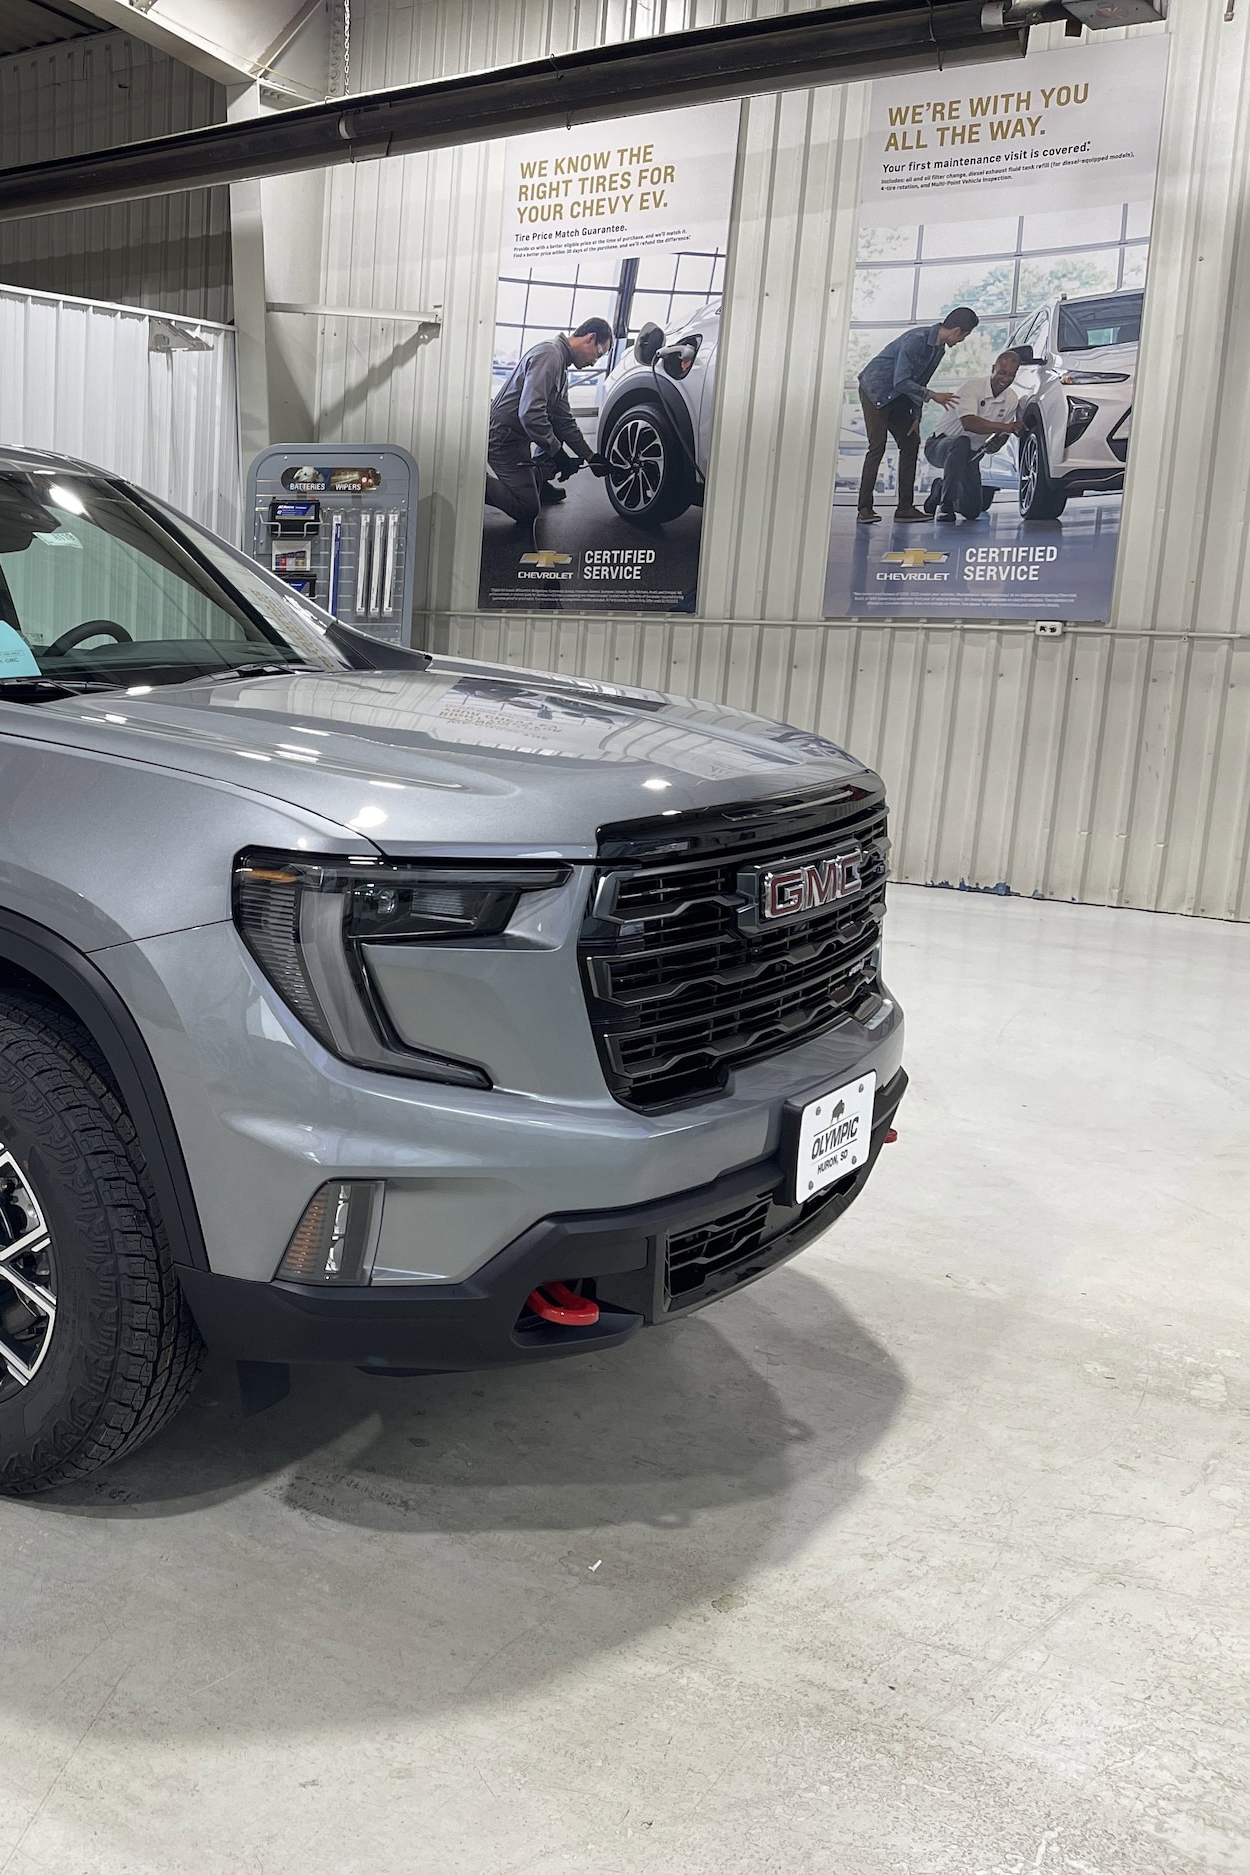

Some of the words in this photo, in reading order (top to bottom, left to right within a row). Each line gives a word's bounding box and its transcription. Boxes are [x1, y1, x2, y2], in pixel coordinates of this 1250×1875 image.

[888, 100, 961, 127] WE'RE
[969, 91, 1031, 118] WITH
[1040, 83, 1089, 108] YOU
[884, 129, 928, 152] ALL
[936, 123, 981, 147] THE
[989, 115, 1046, 141] WAY.
[520, 160, 549, 179] WE
[554, 151, 611, 176] KNOW
[617, 144, 654, 167] THE
[883, 163, 906, 173] Your
[908, 161, 931, 171] first
[933, 154, 1001, 169] maintenance
[1004, 150, 1027, 161] visit
[1030, 149, 1039, 159] is
[946, 171, 968, 179] change,
[985, 167, 1007, 175] exhaust
[1062, 154, 1109, 166] diesel-equipped
[518, 179, 573, 202] RIGHT
[578, 171, 632, 195] TIRES
[638, 165, 675, 187] FOR
[931, 180, 961, 188] Multi-Point
[962, 177, 981, 185] Vehicle
[516, 203, 564, 224] YOUR
[570, 193, 634, 220] CHEVY
[639, 189, 668, 211] EV.
[515, 233, 530, 242] Tire
[532, 231, 553, 241] Price
[555, 228, 580, 239] Match
[581, 224, 628, 236] Guarantee.
[289, 482, 326, 491] BATTERIES
[335, 483, 362, 491] WIPERS
[584, 550, 656, 564] CERTIFIED
[965, 546, 1058, 563] CERTIFIED
[517, 571, 574, 580] CHEVROLET
[583, 566, 642, 580] SERVICE
[876, 572, 950, 581] CHEVROLET
[963, 565, 1040, 582] SERVICE
[764, 848, 863, 919] GMC
[811, 1116, 859, 1160] OLYMPIC
[817, 1154, 839, 1175] HURON,
[840, 1149, 849, 1161] SD
